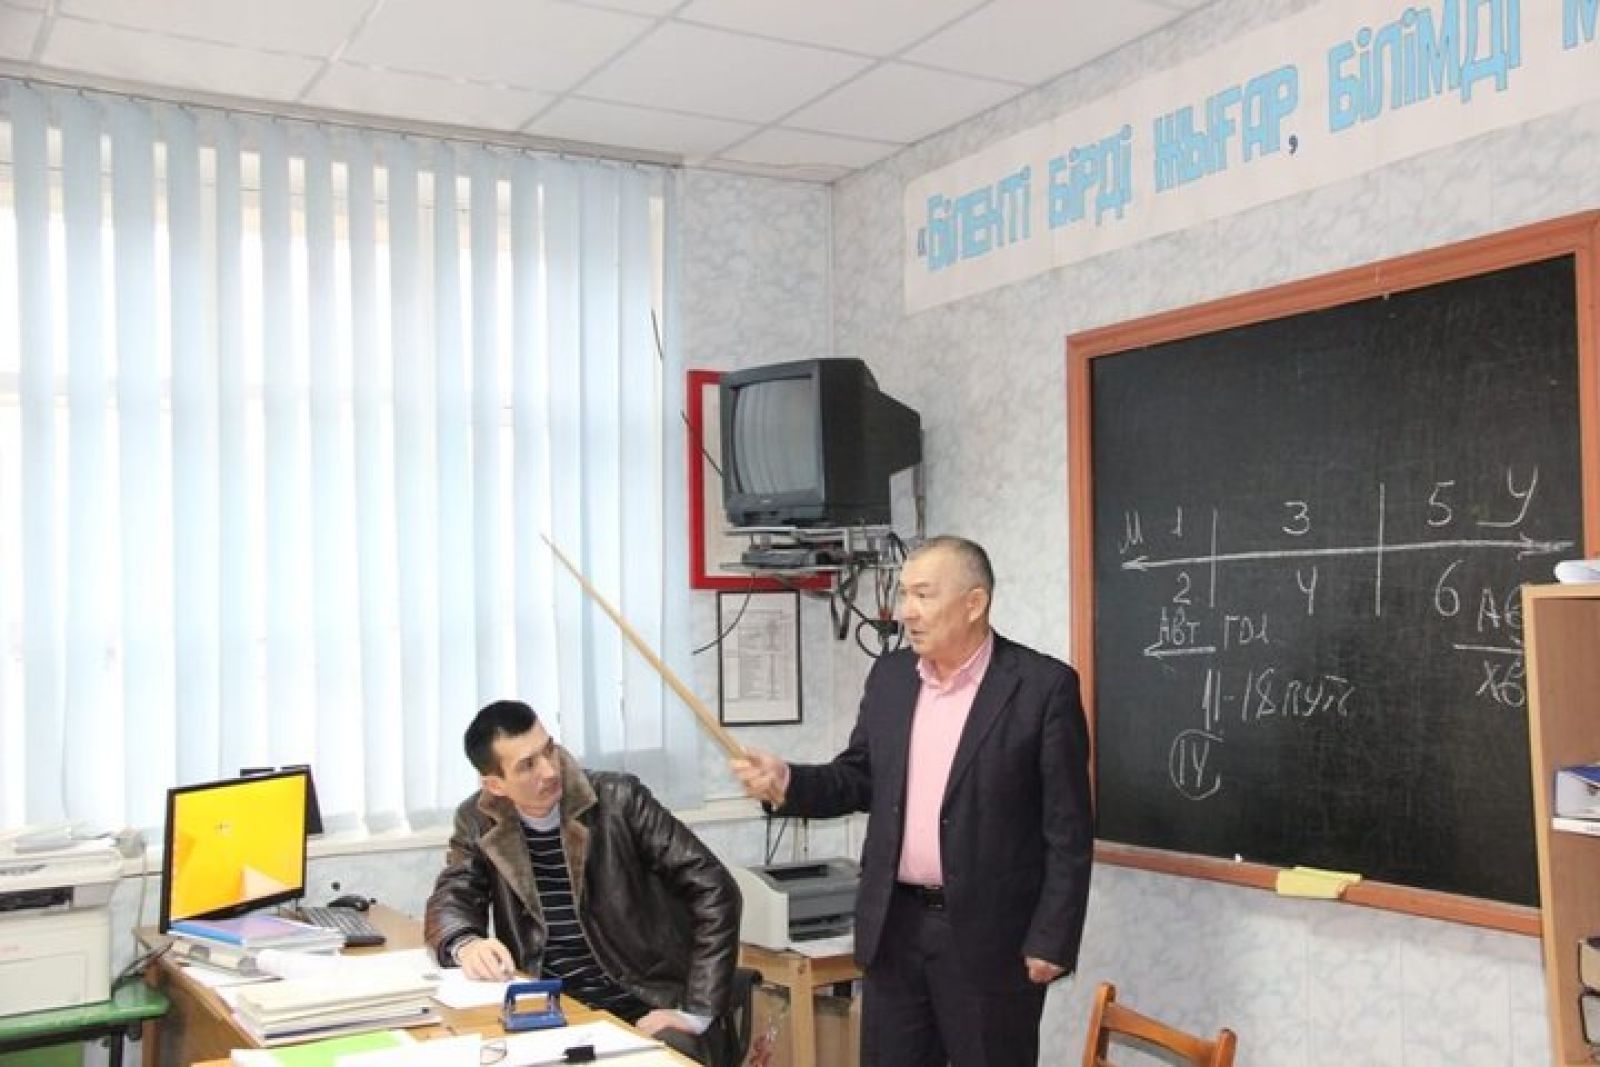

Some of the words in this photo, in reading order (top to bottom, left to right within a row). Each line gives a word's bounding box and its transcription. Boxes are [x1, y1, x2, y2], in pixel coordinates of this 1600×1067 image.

[1281, 500, 1310, 536] 3
[1427, 479, 1456, 526] 5
[1172, 570, 1192, 606] 2
[1434, 559, 1465, 617] 6
